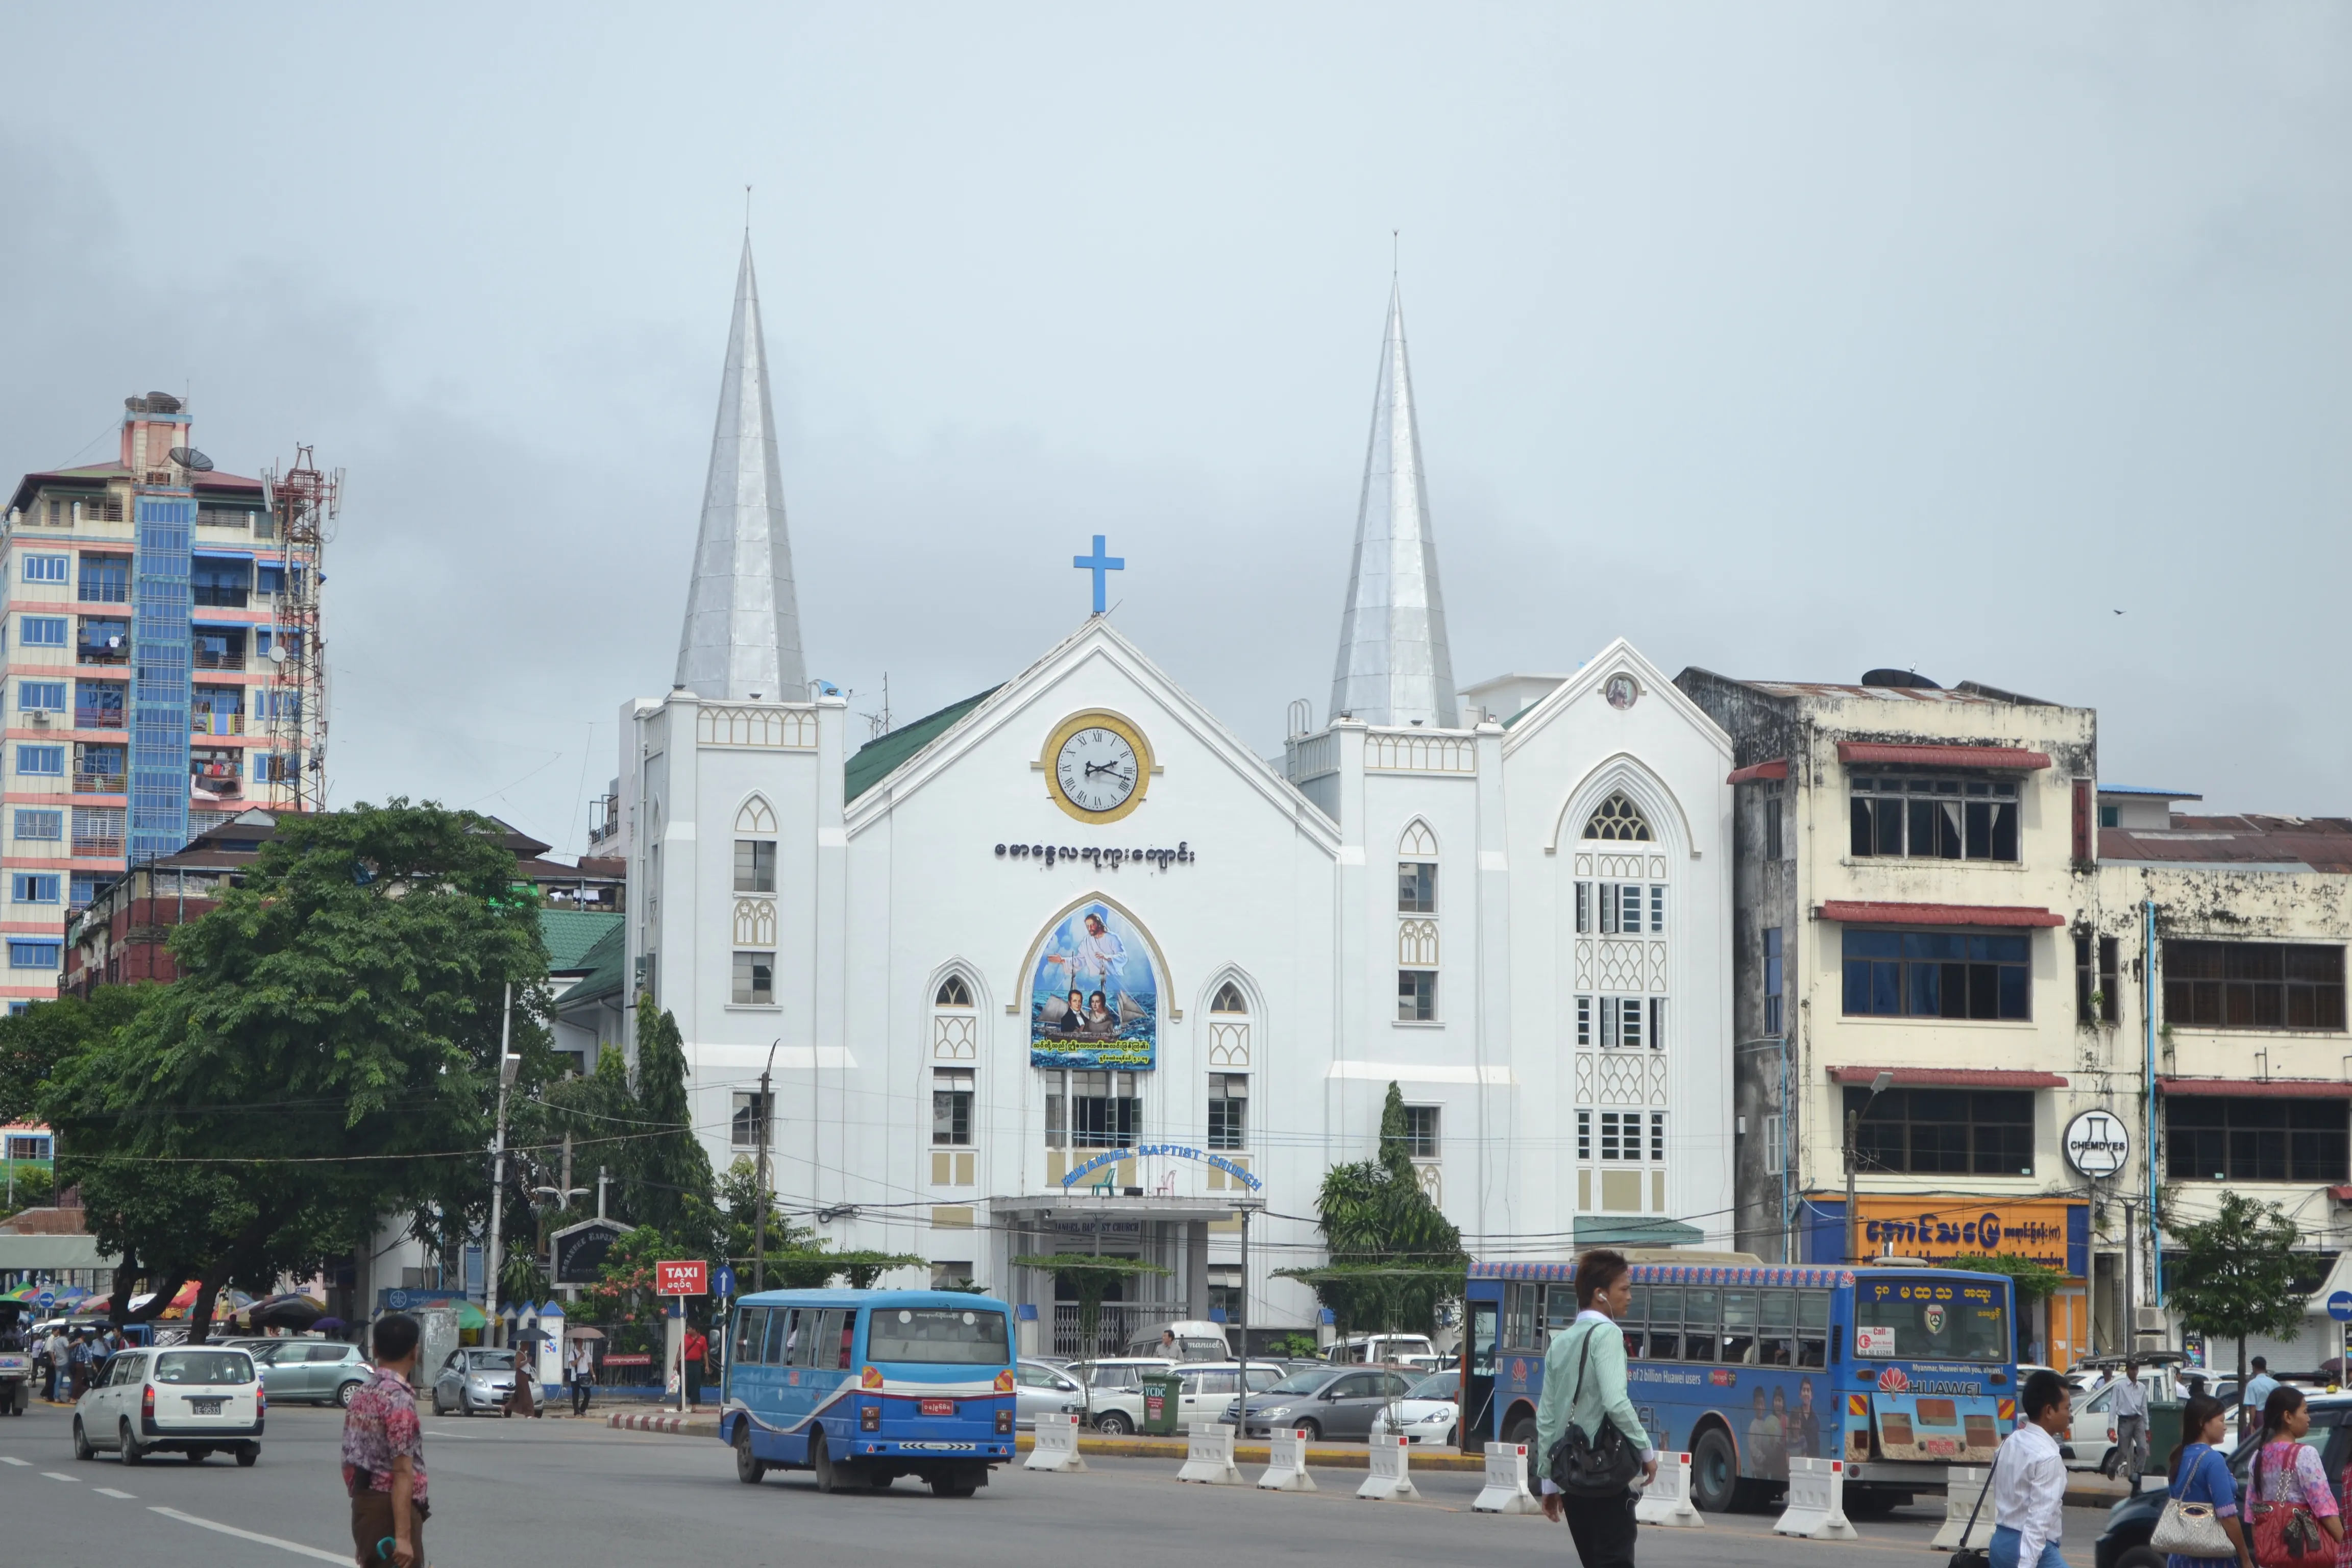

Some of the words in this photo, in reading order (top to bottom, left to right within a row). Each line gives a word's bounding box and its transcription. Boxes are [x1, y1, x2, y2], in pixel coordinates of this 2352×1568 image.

[2071, 1141, 2125, 1152] CHEMDYES
[1061, 1147, 1133, 1188] IMMANUEL
[1139, 1144, 1202, 1161] BAPTIST
[1209, 1155, 1263, 1192] CHURCH
[1082, 1222, 1111, 1232] BAPST
[1113, 1222, 1139, 1232] CHURCH
[666, 1267, 698, 1278] TAXI
[667, 1279, 693, 1292] မရပ်ရ
[1964, 1289, 1991, 1304] အထူး
[1913, 1364, 1938, 1373] Myanmar,
[1939, 1364, 1959, 1373] Huawei
[1633, 1368, 1639, 1381] of
[1639, 1369, 1643, 1381] 2
[1644, 1368, 1662, 1382] billion
[1663, 1370, 1684, 1384] Huawei
[1685, 1374, 1701, 1385] users
[1145, 1387, 1165, 1397] YCDC
[1908, 1380, 1981, 1398] HUAWEI
[195, 1406, 219, 1414] 1E-9533
